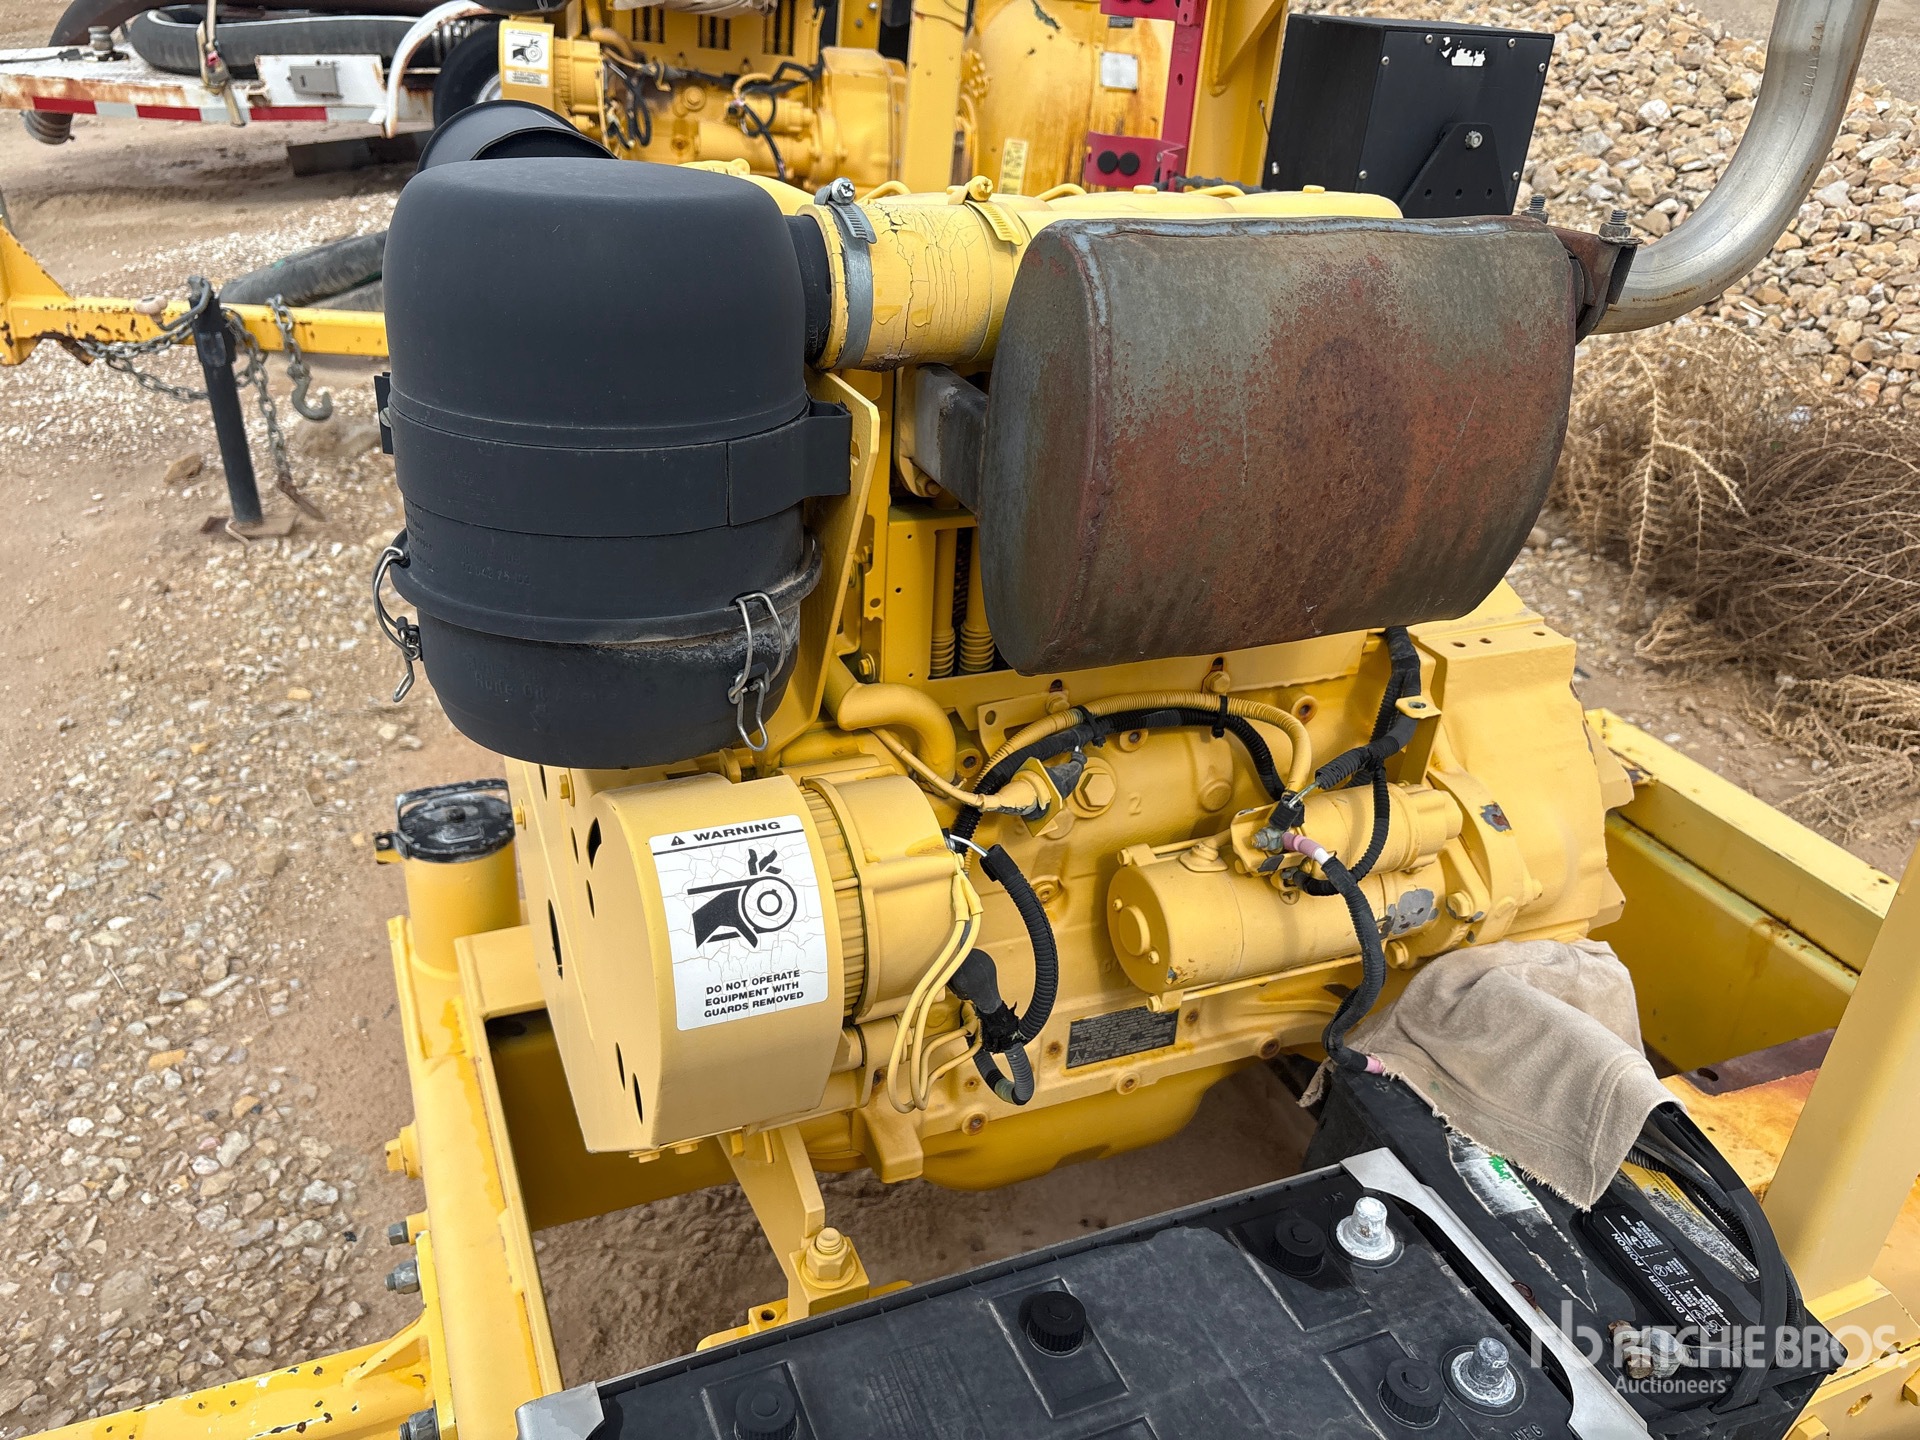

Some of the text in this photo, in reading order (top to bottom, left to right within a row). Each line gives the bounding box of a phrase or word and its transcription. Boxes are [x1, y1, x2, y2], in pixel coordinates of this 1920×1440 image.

[693, 822, 781, 842] WARNING
[705, 981, 799, 1007] EQUIPMENT WITH
[706, 970, 801, 995] DO NOT OPERATE
[704, 991, 804, 1018] GUARDS REMOVED
[1610, 1232, 1644, 1265] POISON
[1647, 1275, 1686, 1313] DANGER
